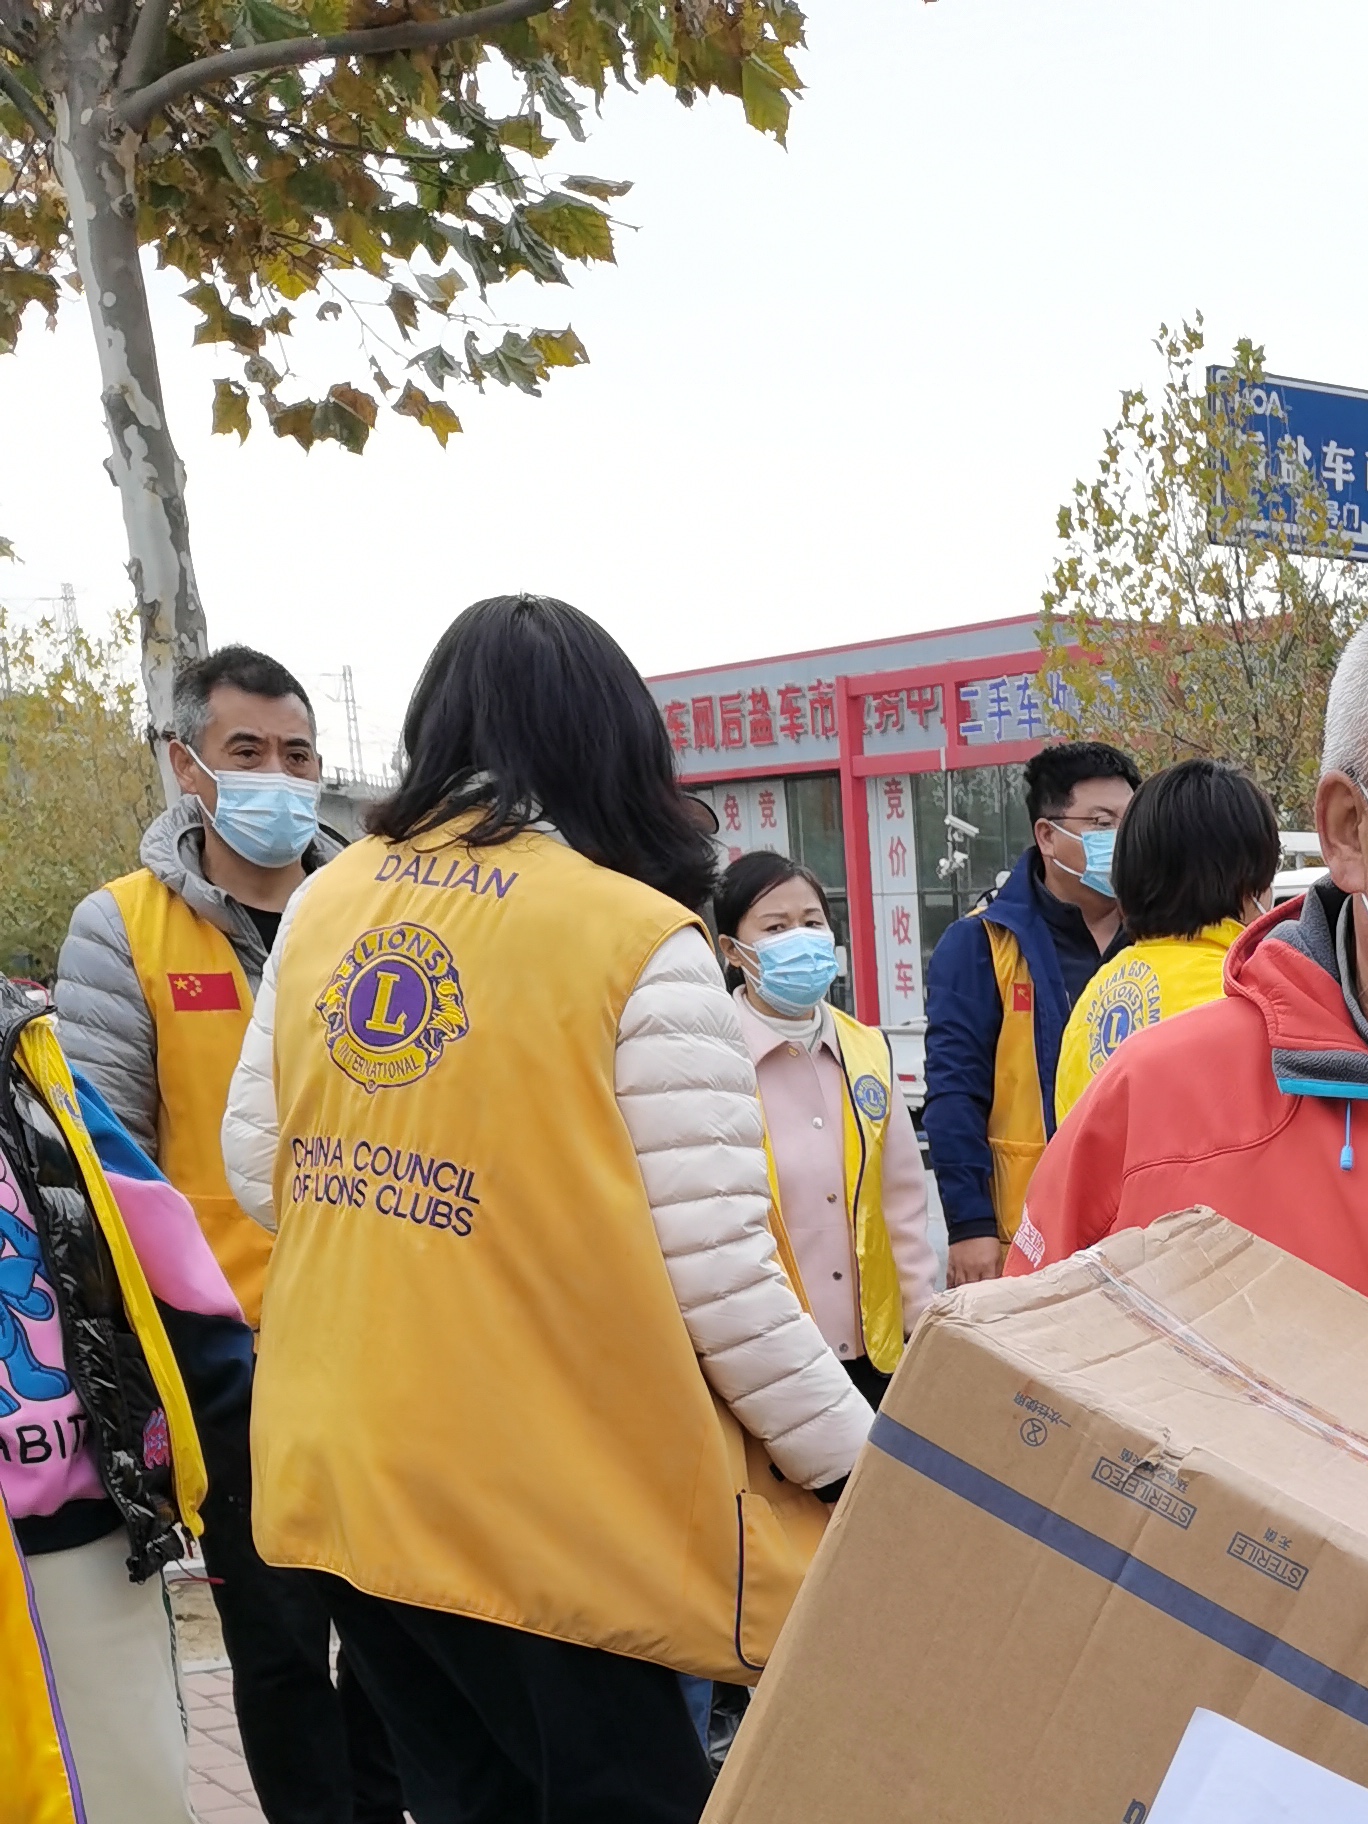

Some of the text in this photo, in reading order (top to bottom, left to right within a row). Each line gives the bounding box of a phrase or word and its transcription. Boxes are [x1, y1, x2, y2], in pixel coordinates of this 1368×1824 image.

[375, 854, 519, 898] DALIAN
[884, 777, 914, 998] 竞价收车
[359, 926, 447, 970] LIONS
[365, 970, 407, 1036] L
[1105, 985, 1139, 1007] LIONS
[1144, 974, 1161, 1024] TEAM
[339, 1042, 421, 1080] INTERNATIONAL
[292, 1136, 481, 1204] CHINA COUNCIL
[292, 1173, 474, 1238] OF LIONS CLUBS
[1013, 1390, 1072, 1429] 一次性使用
[1121, 1469, 1193, 1525] STERILE
[1232, 1537, 1303, 1585] STERILE
[1263, 1526, 1294, 1551] 无菌
